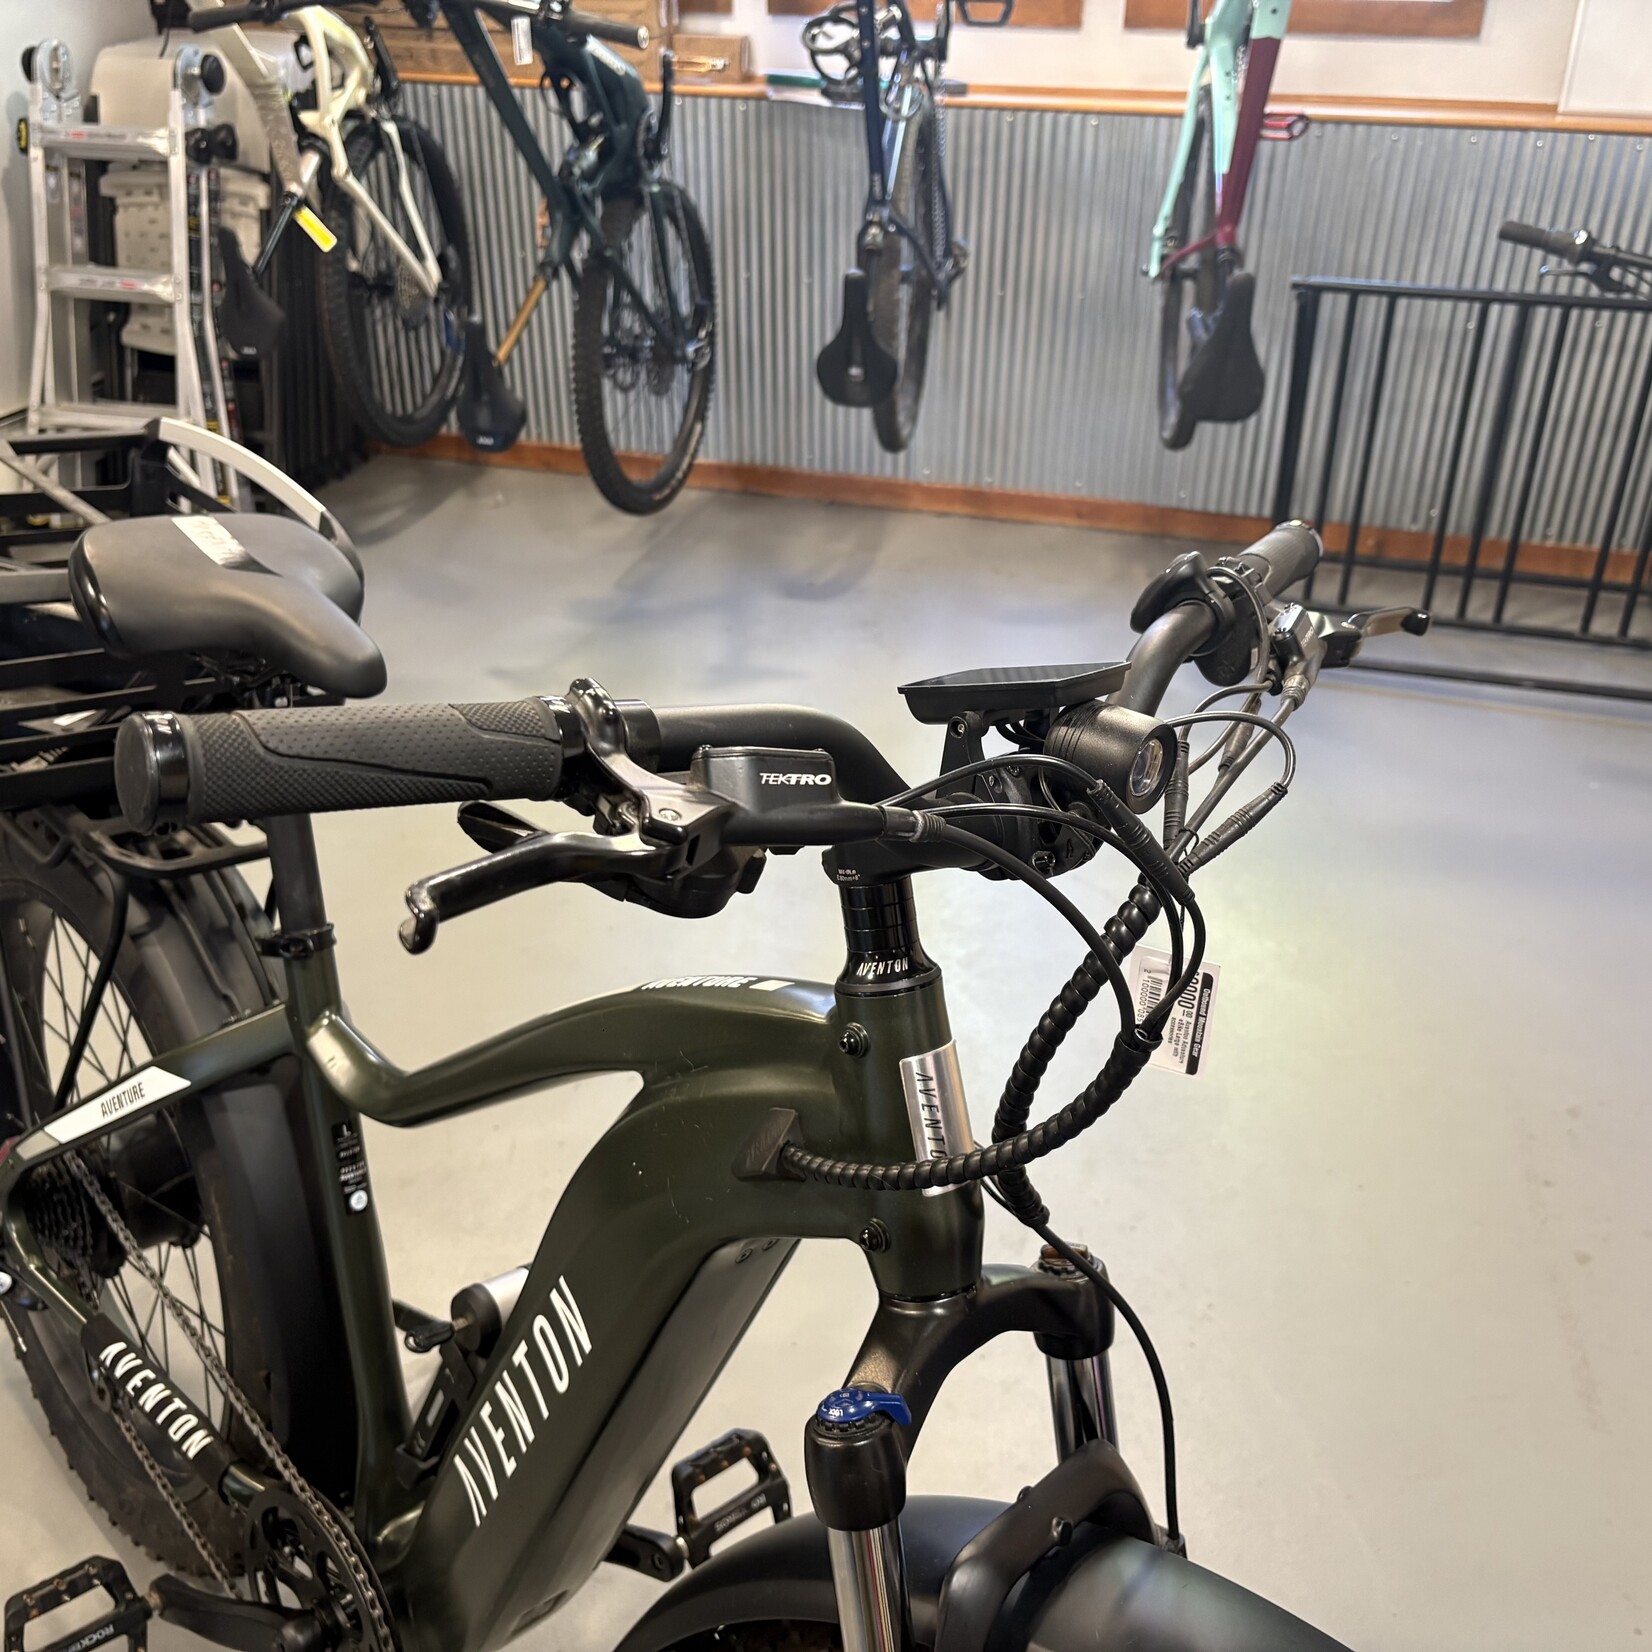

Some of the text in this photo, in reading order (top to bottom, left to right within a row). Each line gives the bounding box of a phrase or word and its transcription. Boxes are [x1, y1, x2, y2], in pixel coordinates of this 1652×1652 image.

[759, 772, 832, 786] TEKTRO
[856, 957, 909, 976] AVENTON
[1195, 1015, 1205, 1042] Mountain
[1191, 1043, 1201, 1057] Gear
[100, 1082, 146, 1118] AVENTURE
[915, 1072, 948, 1159] AVENTO
[99, 1341, 215, 1460] AVENTON
[452, 1275, 593, 1527] AVENTON
